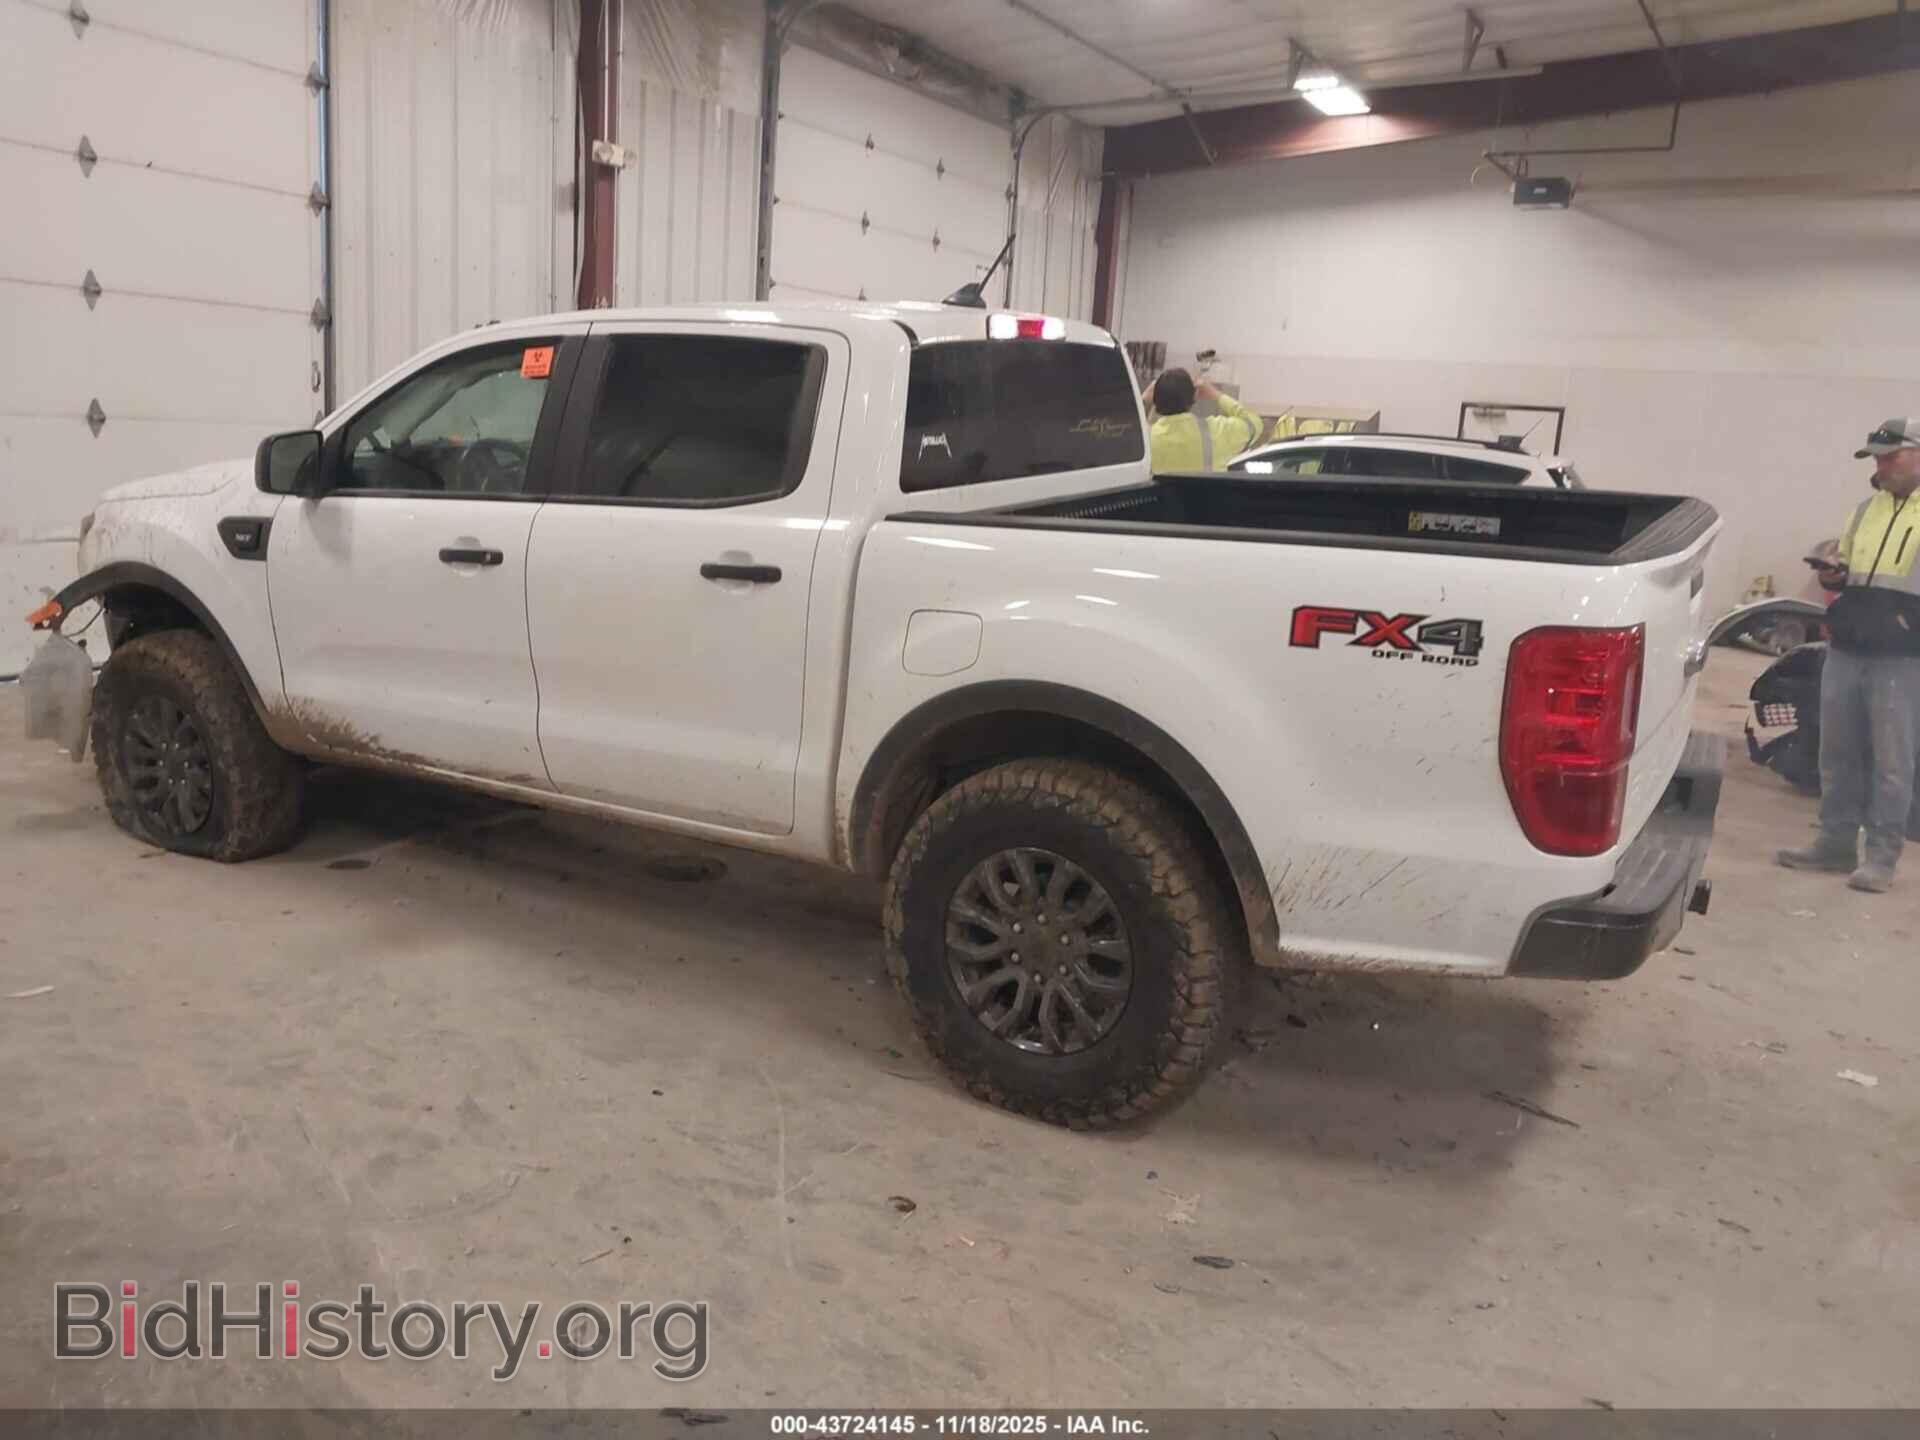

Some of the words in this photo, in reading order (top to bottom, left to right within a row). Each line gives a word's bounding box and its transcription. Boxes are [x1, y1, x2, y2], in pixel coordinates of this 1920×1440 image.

[1289, 605, 1484, 656] FX4
[1371, 649, 1414, 660] OFF
[1421, 653, 1480, 667] ROAD
